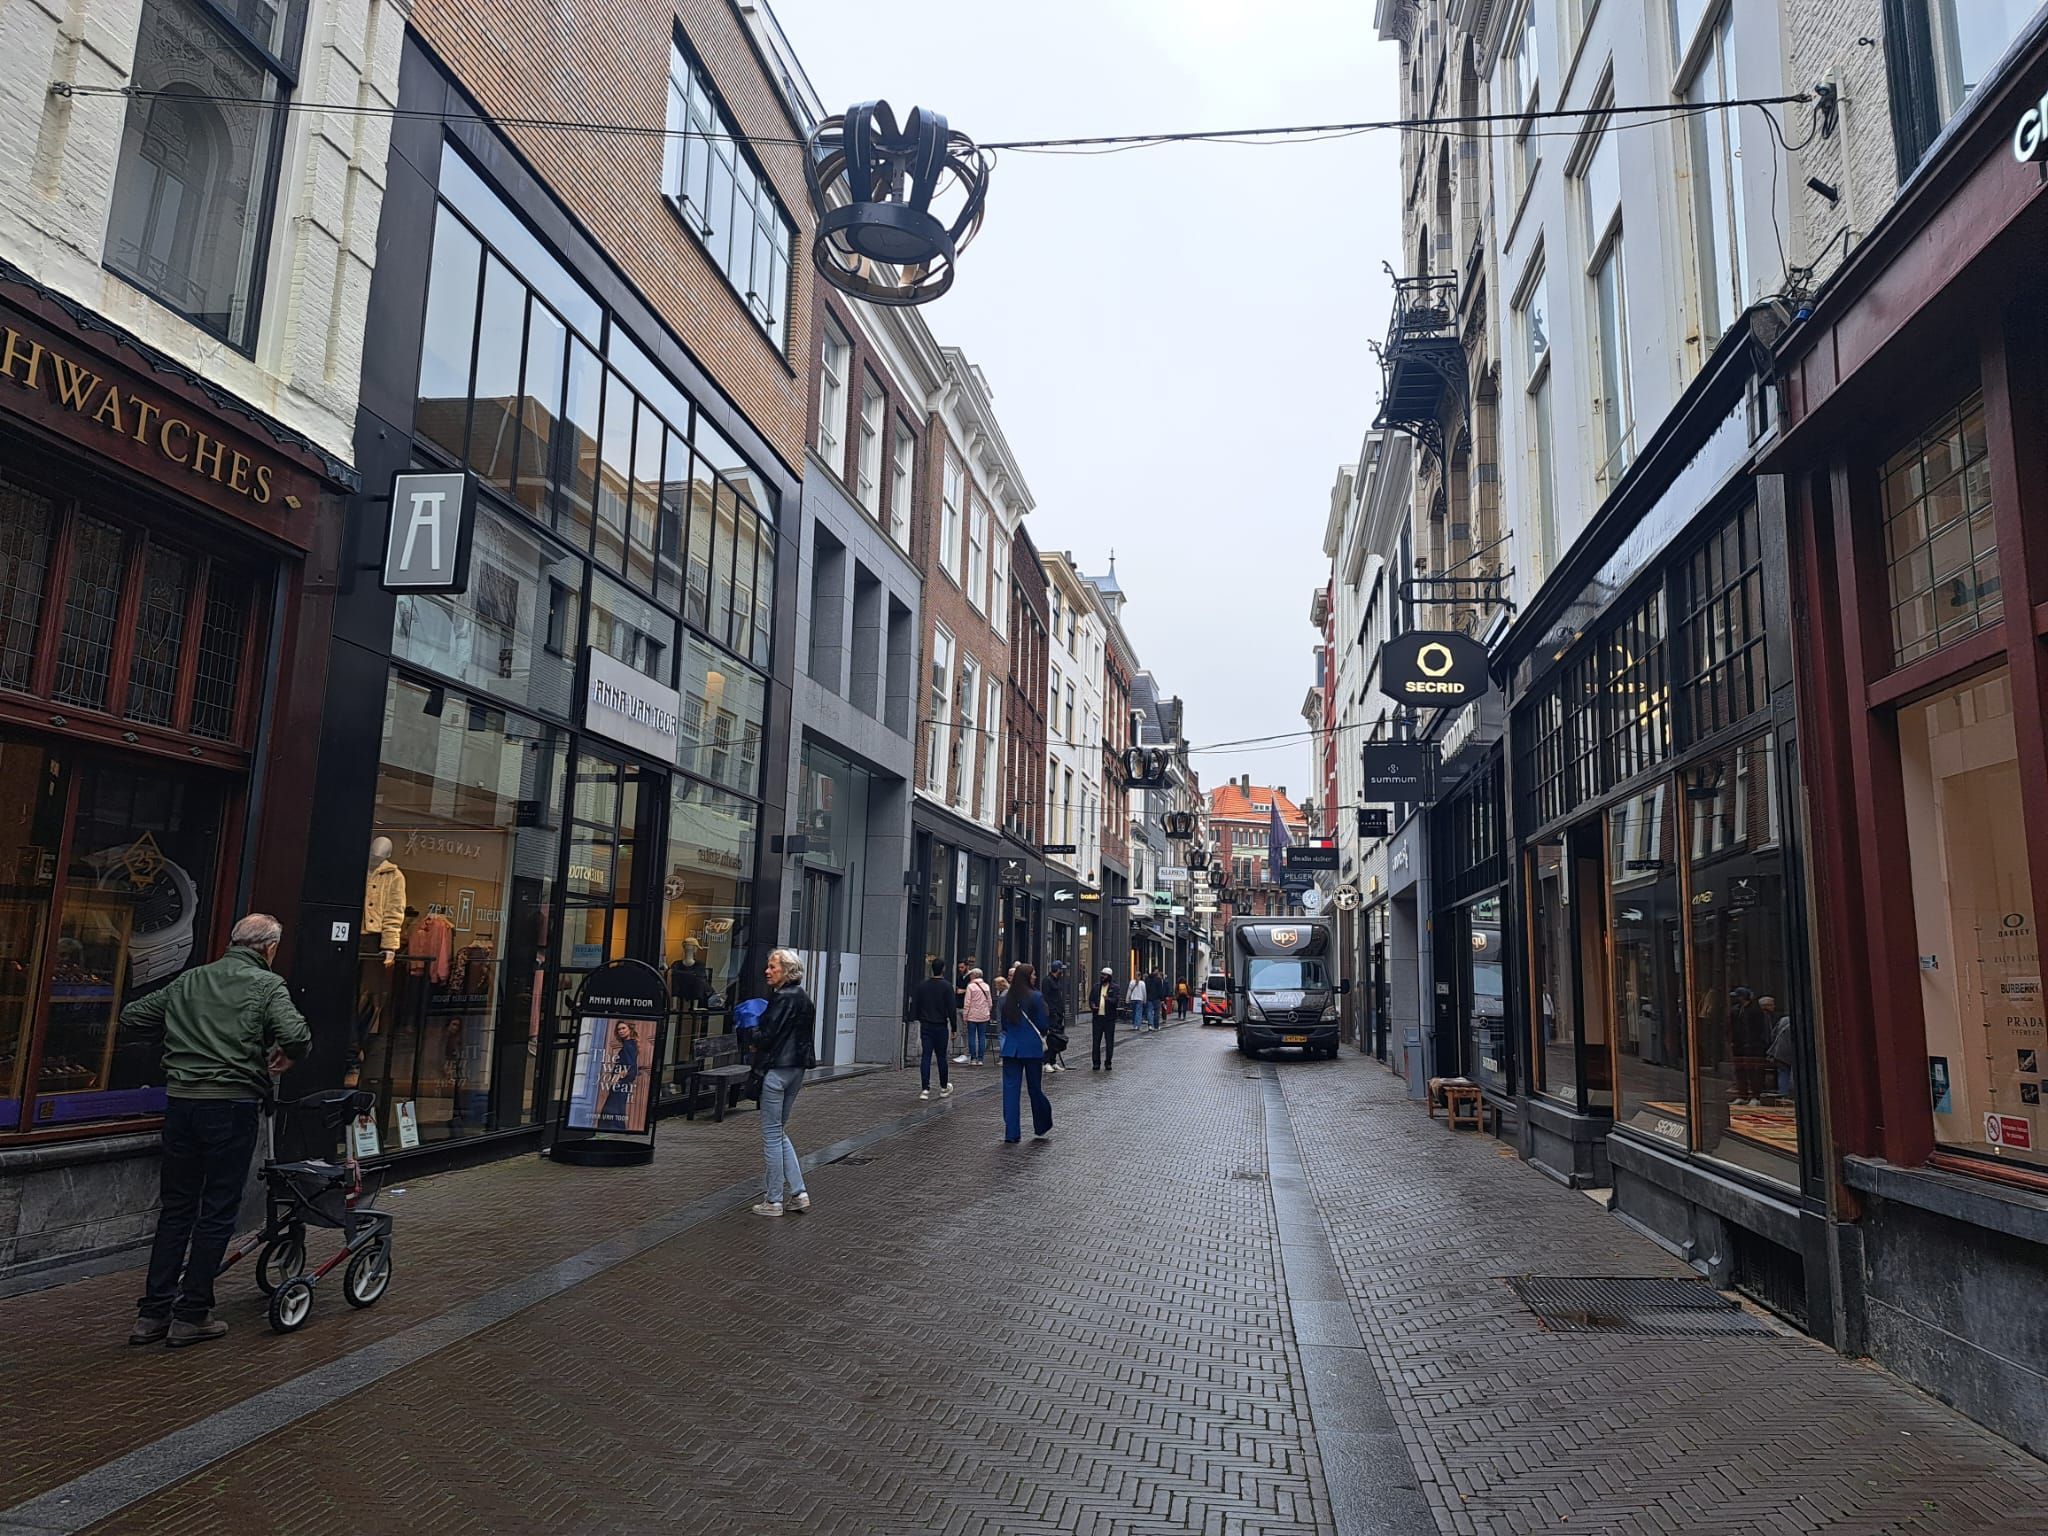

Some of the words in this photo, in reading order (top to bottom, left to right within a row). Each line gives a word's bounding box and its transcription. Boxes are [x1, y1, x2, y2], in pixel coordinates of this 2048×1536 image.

[1405, 681, 1465, 694] SECRID
[594, 679, 627, 713] ANNA
[628, 695, 651, 724] VAN
[652, 706, 677, 736] TOOR
[1371, 776, 1417, 784] summum
[335, 926, 346, 938] 29
[1273, 932, 1296, 944] ups
[2001, 982, 2040, 994] BURBERRY
[589, 996, 612, 1005] ANNA
[614, 997, 631, 1006] VAN
[633, 998, 653, 1007] TOOR
[2007, 1016, 2045, 1027] PRADA
[590, 1048, 621, 1063] The
[602, 1063, 632, 1077] way
[600, 1082, 637, 1093] wear
[1654, 1119, 1685, 1138] SECRID
